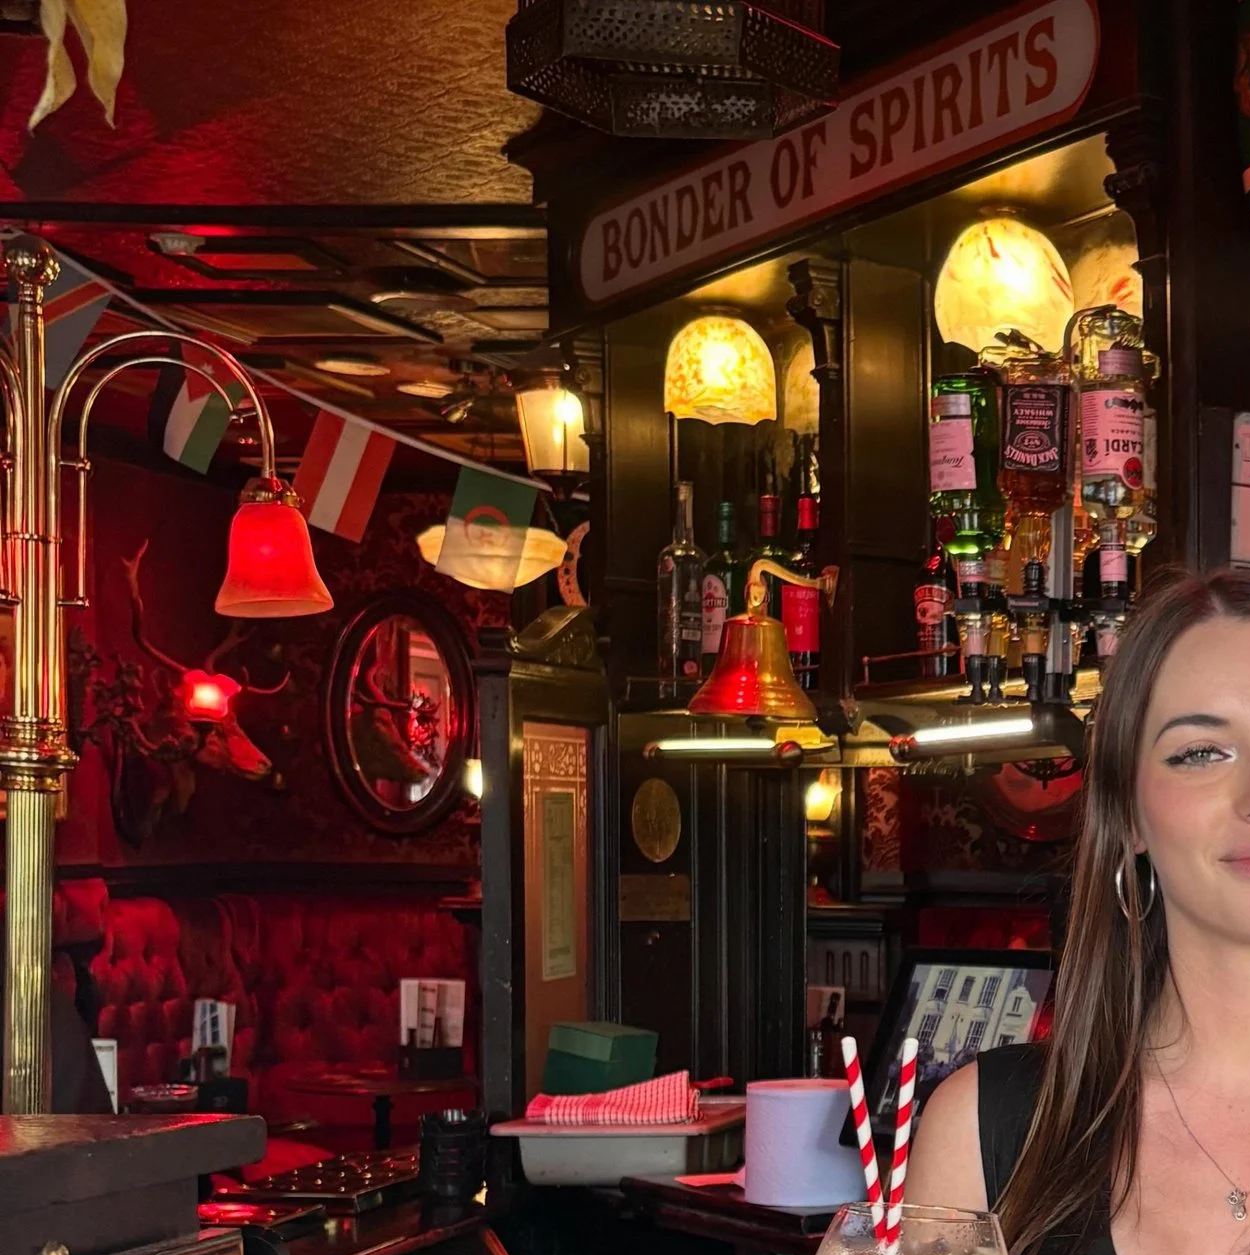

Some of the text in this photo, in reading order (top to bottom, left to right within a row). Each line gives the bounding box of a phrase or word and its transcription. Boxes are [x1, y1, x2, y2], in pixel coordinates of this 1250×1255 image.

[602, 17, 1057, 282] BONDER OF SPIRITS
[1003, 445, 1059, 467] JACK DANIEL'S
[1105, 439, 1143, 456] CARDÍ
